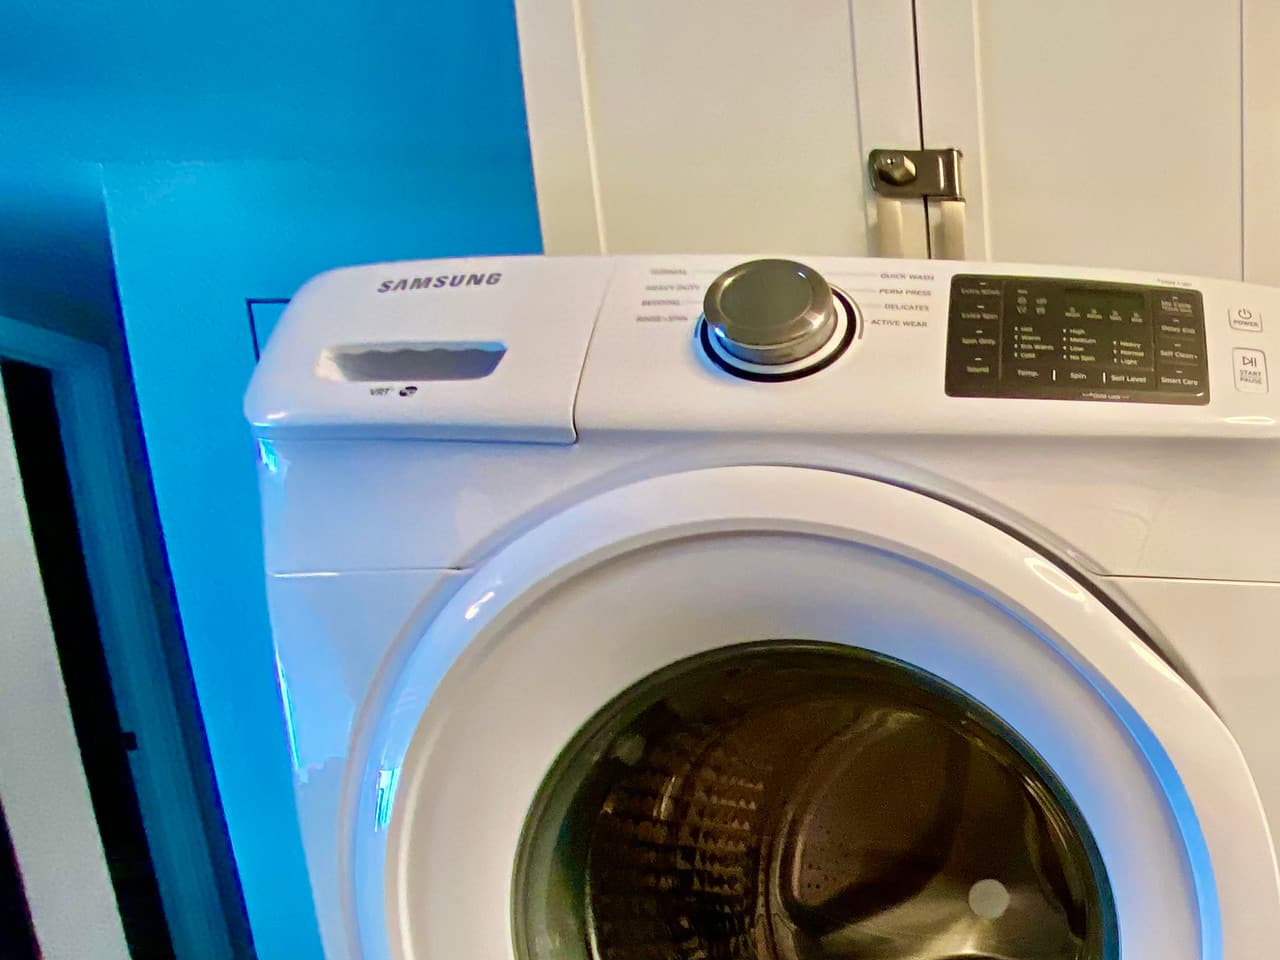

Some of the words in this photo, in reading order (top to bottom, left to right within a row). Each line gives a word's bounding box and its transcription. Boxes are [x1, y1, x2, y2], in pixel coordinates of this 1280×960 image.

[377, 273, 502, 293] SAMSUNG
[884, 303, 929, 312] DELICATES
[870, 319, 900, 327] ACTIVE
[902, 320, 928, 328] WEAR
[1233, 319, 1259, 327] POWER
